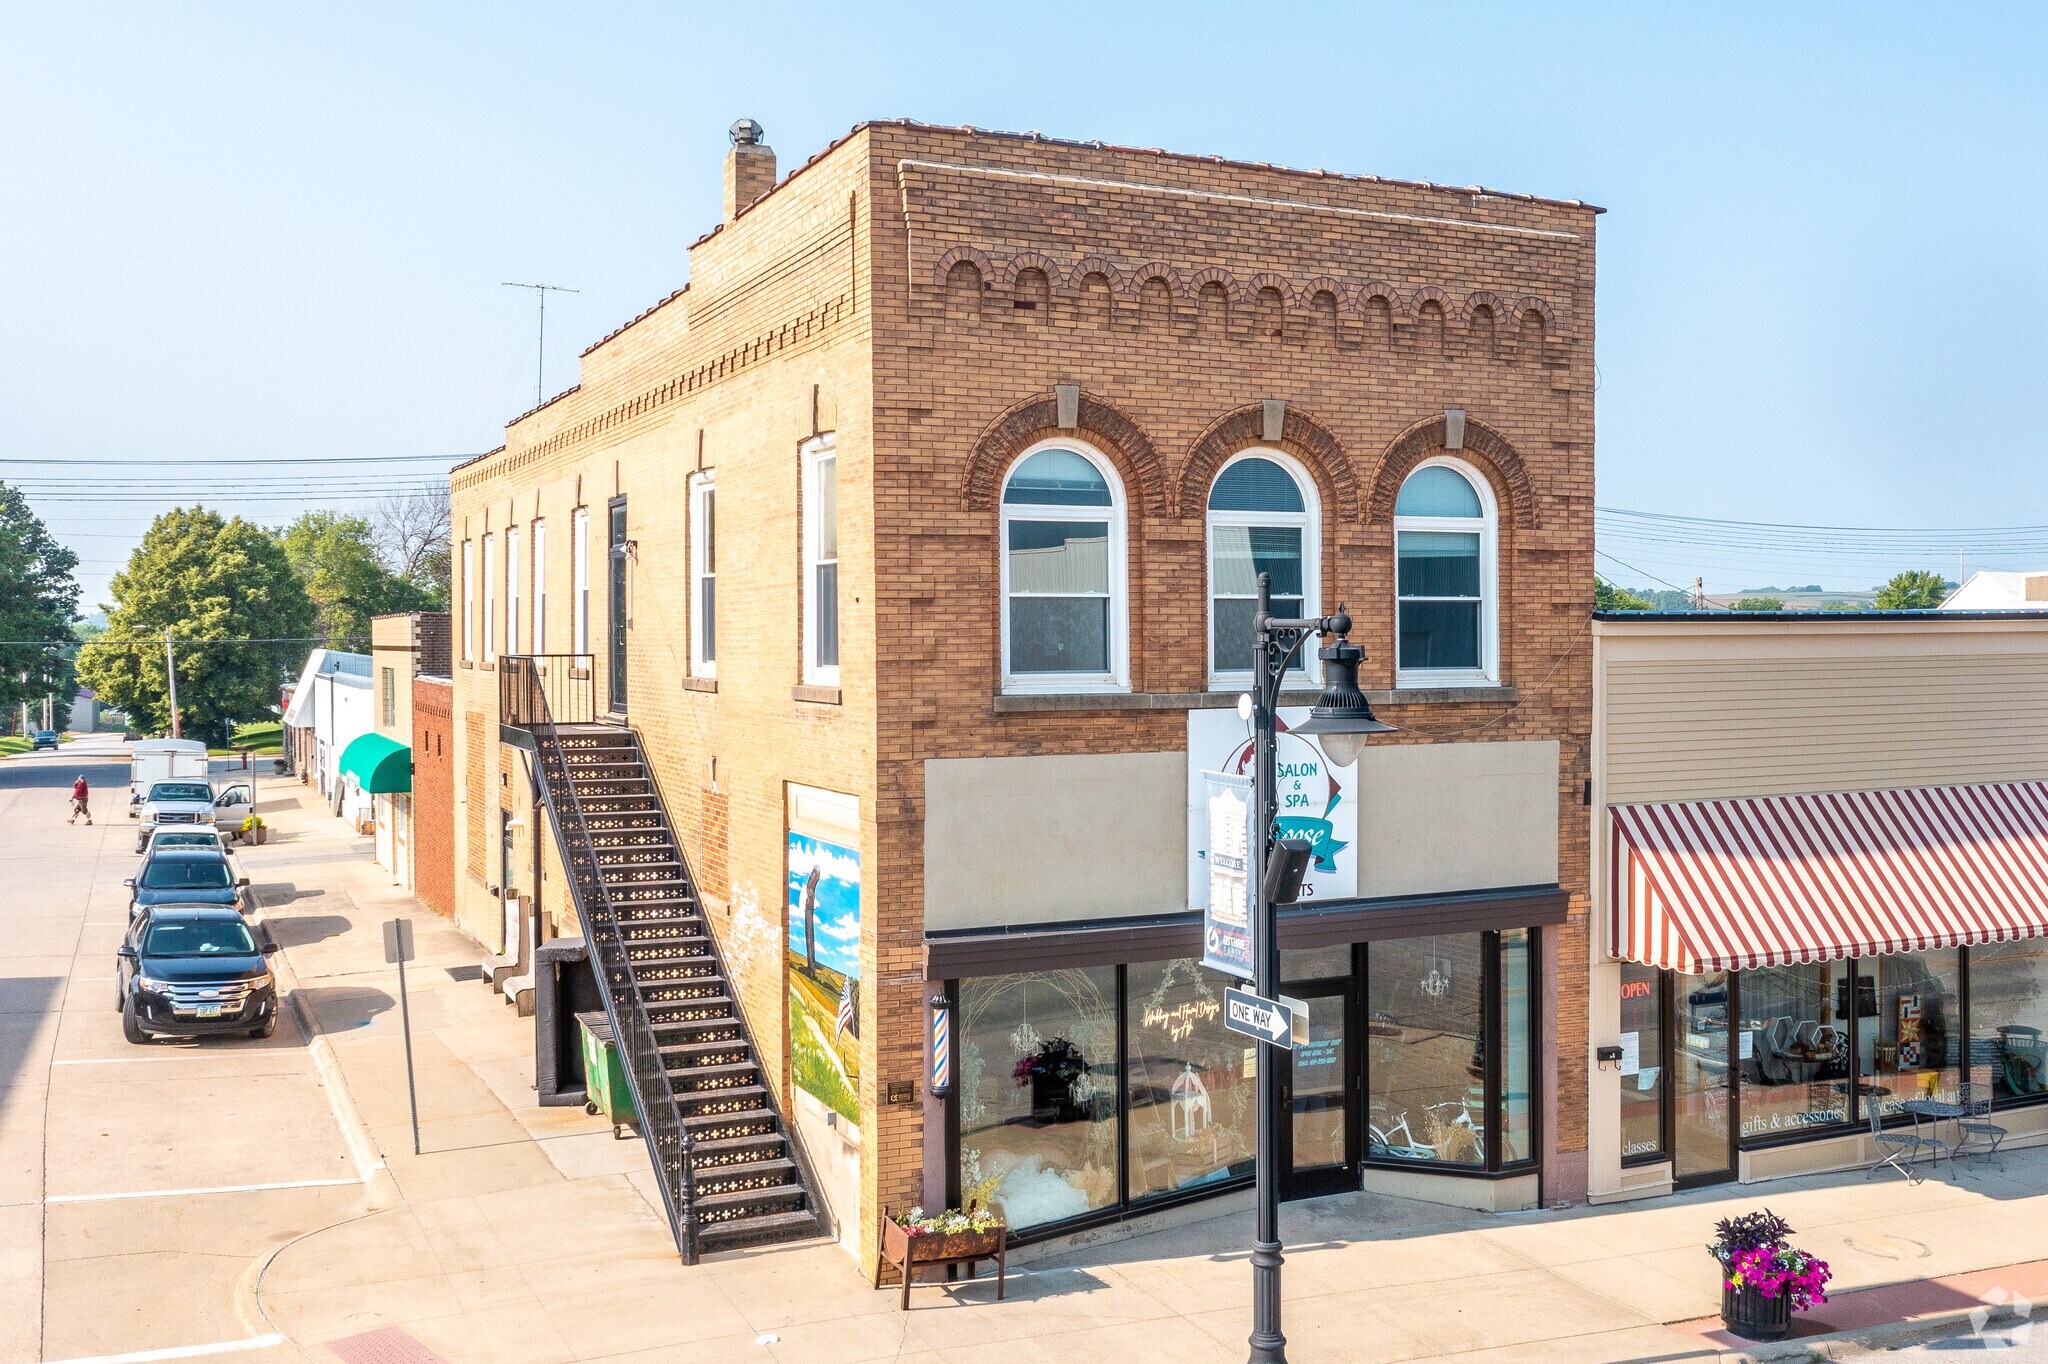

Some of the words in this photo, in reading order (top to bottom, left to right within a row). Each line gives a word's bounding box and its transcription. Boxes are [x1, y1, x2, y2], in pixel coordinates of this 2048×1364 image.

[1277, 762, 1317, 777] SALON
[1293, 780, 1301, 790] &
[1285, 794, 1309, 808] SPA
[1214, 855, 1241, 869] WELCOME
[1621, 980, 1650, 999] OPEN
[1232, 1003, 1249, 1021] ONE
[1253, 1009, 1271, 1028] WAY
[1858, 1098, 1906, 1116] shwcase
[1742, 1115, 1767, 1137] gifts
[1770, 1112, 1781, 1129] &
[1784, 1105, 1846, 1127] accessories
[1622, 1139, 1657, 1155] classes
